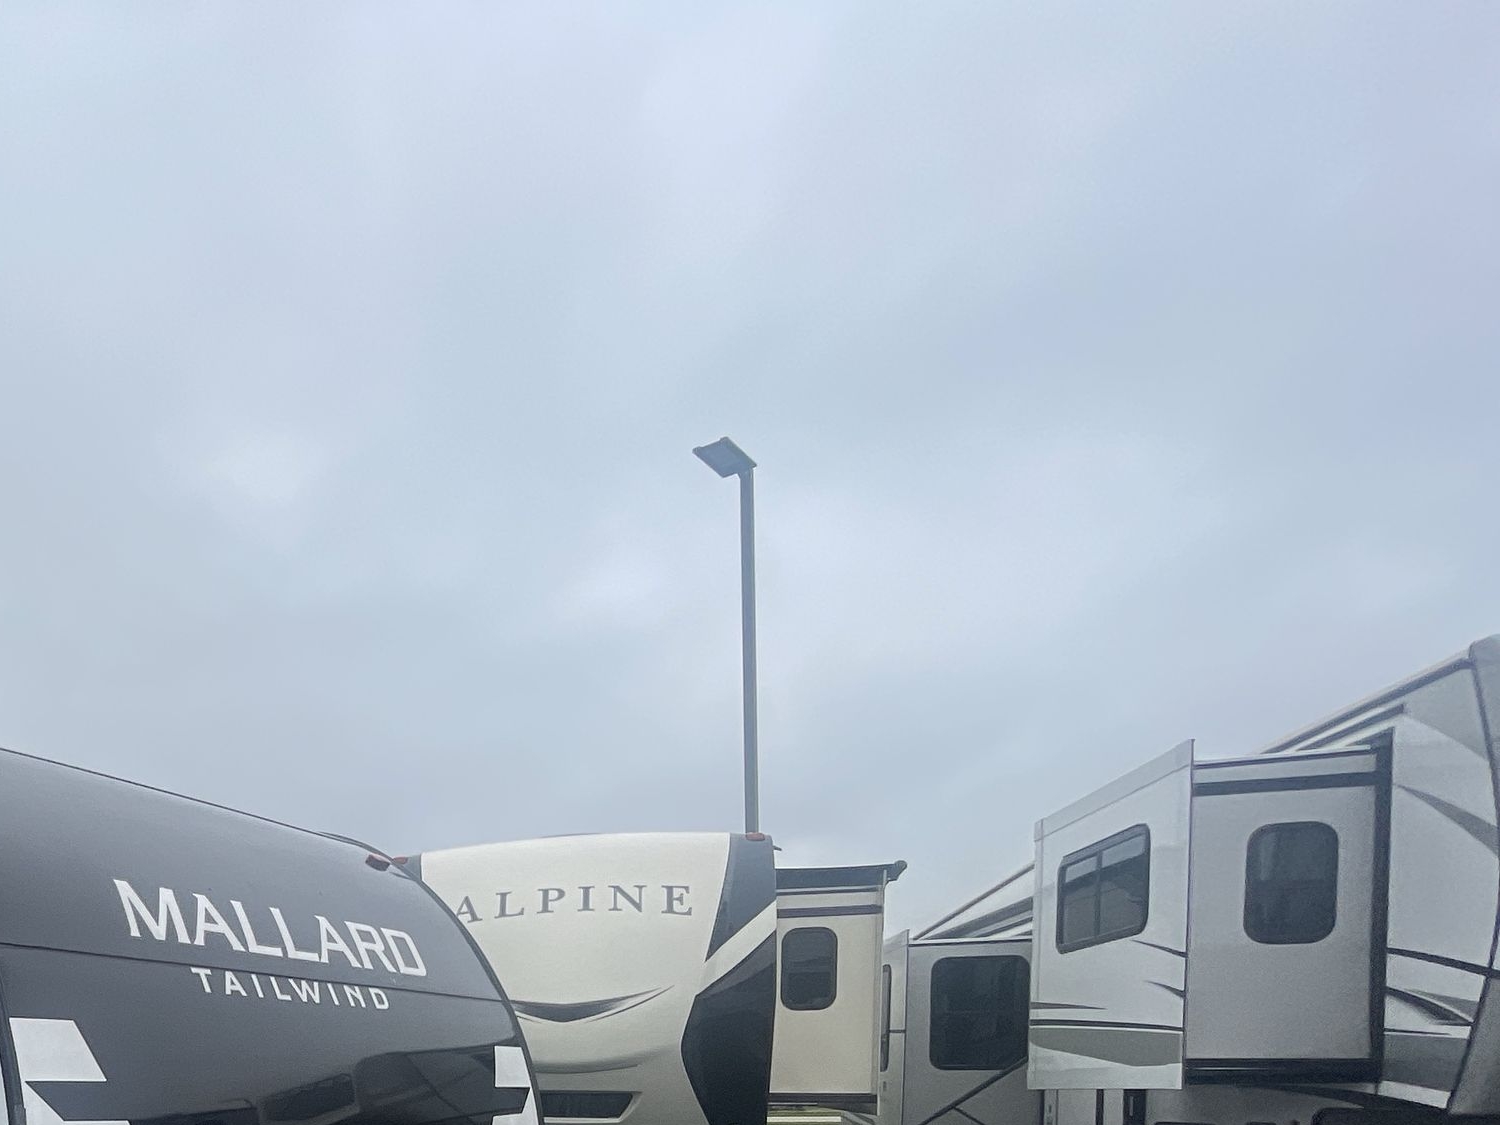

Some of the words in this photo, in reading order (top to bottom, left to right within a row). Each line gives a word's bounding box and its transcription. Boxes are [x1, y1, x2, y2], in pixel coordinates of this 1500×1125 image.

[456, 884, 693, 924] ALPINE
[112, 878, 427, 977] MALLARD
[190, 966, 390, 1010] TAILWIND
